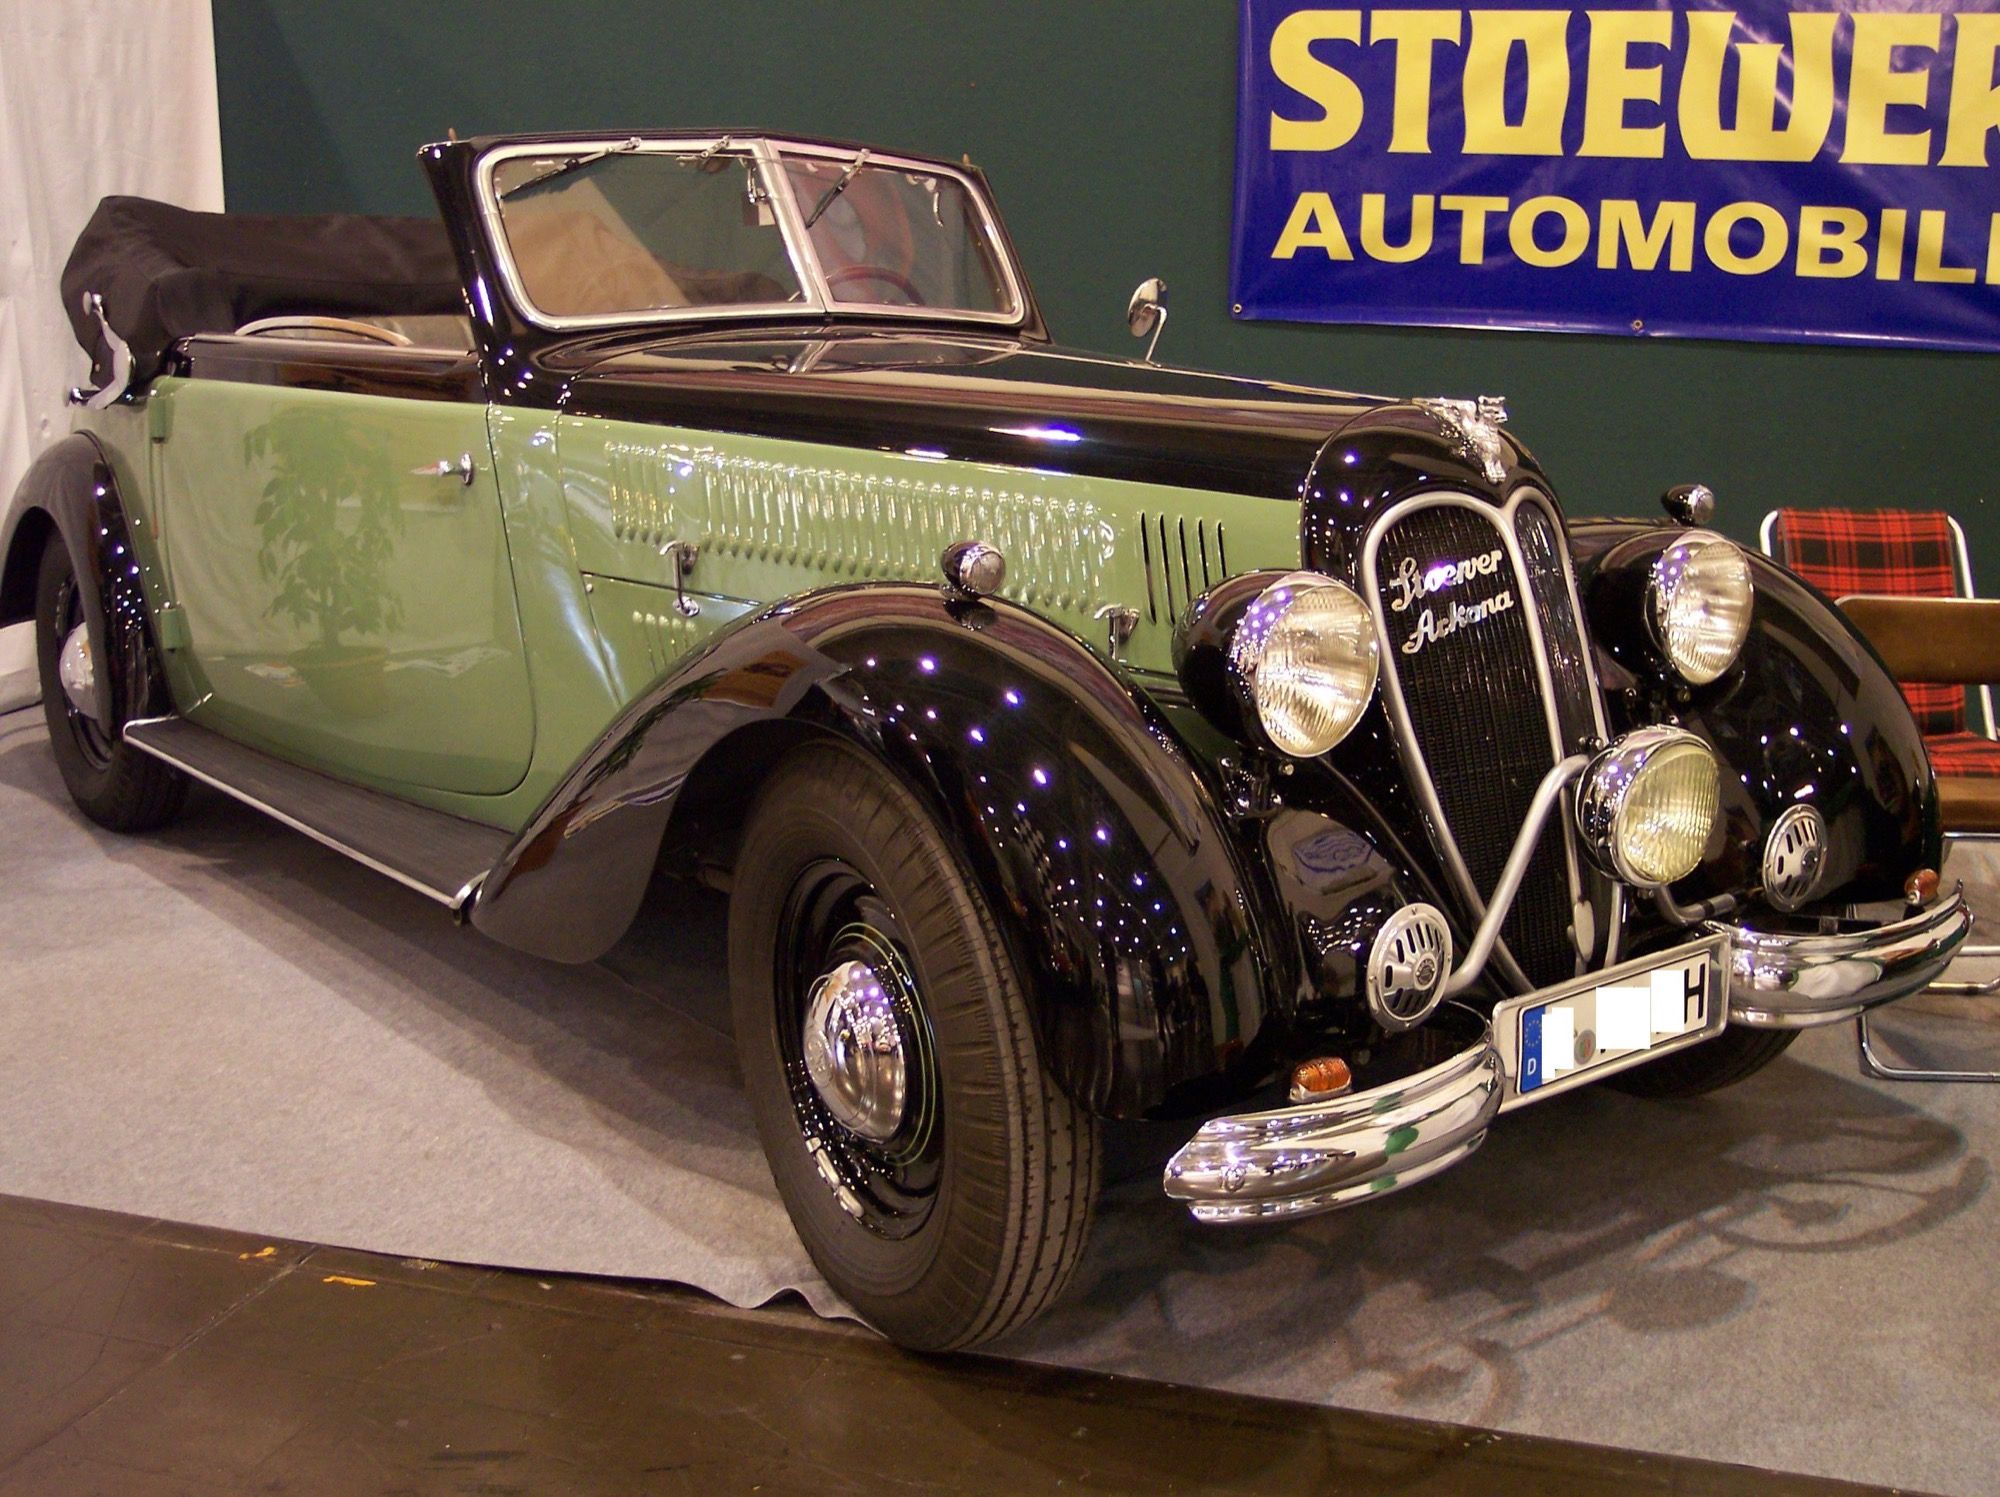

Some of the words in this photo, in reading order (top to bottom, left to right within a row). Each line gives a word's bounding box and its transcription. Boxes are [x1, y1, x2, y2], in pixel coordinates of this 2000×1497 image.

[1271, 191, 2000, 286] AUTOMOBIL
[1389, 550, 1502, 611] Stoewer
[1402, 590, 1514, 654] Arkona
[1527, 1057, 1537, 1076] D
